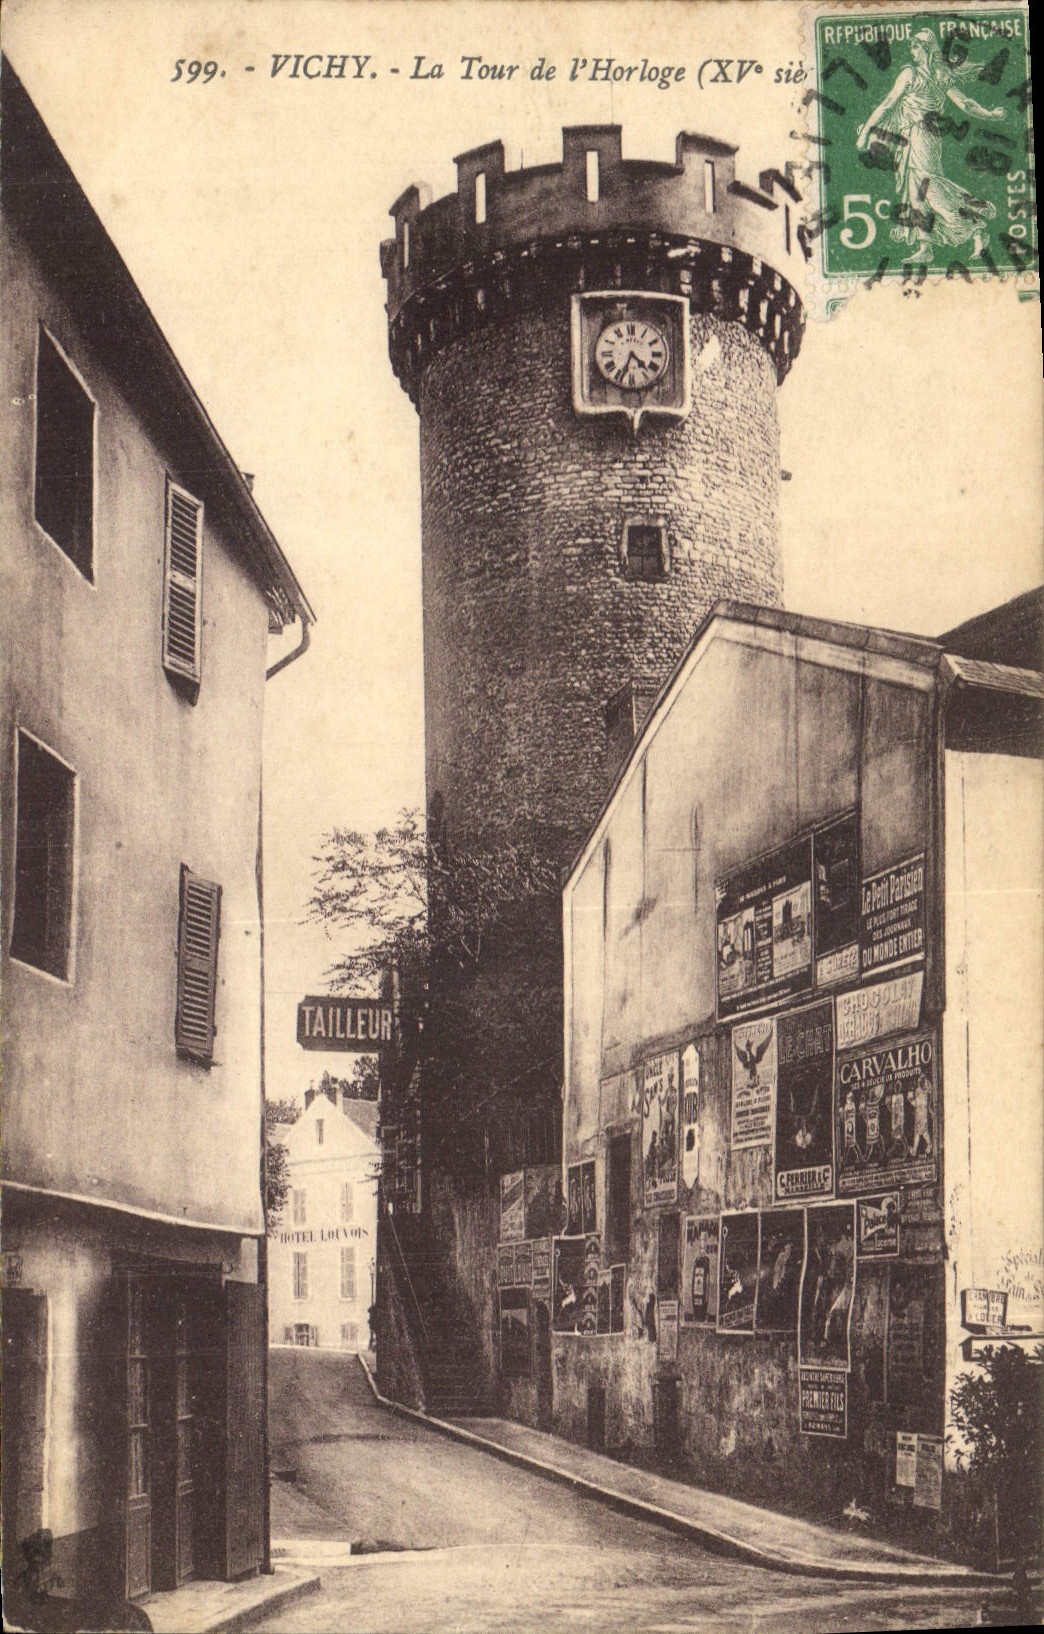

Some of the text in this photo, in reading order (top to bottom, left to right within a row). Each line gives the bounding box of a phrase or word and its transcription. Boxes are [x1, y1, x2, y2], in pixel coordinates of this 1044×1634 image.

[889, 865, 924, 905] Parisien
[873, 937, 898, 964] MONDE
[301, 1004, 393, 1041] TAILLEUR
[840, 1041, 932, 1085] CARVALHO
